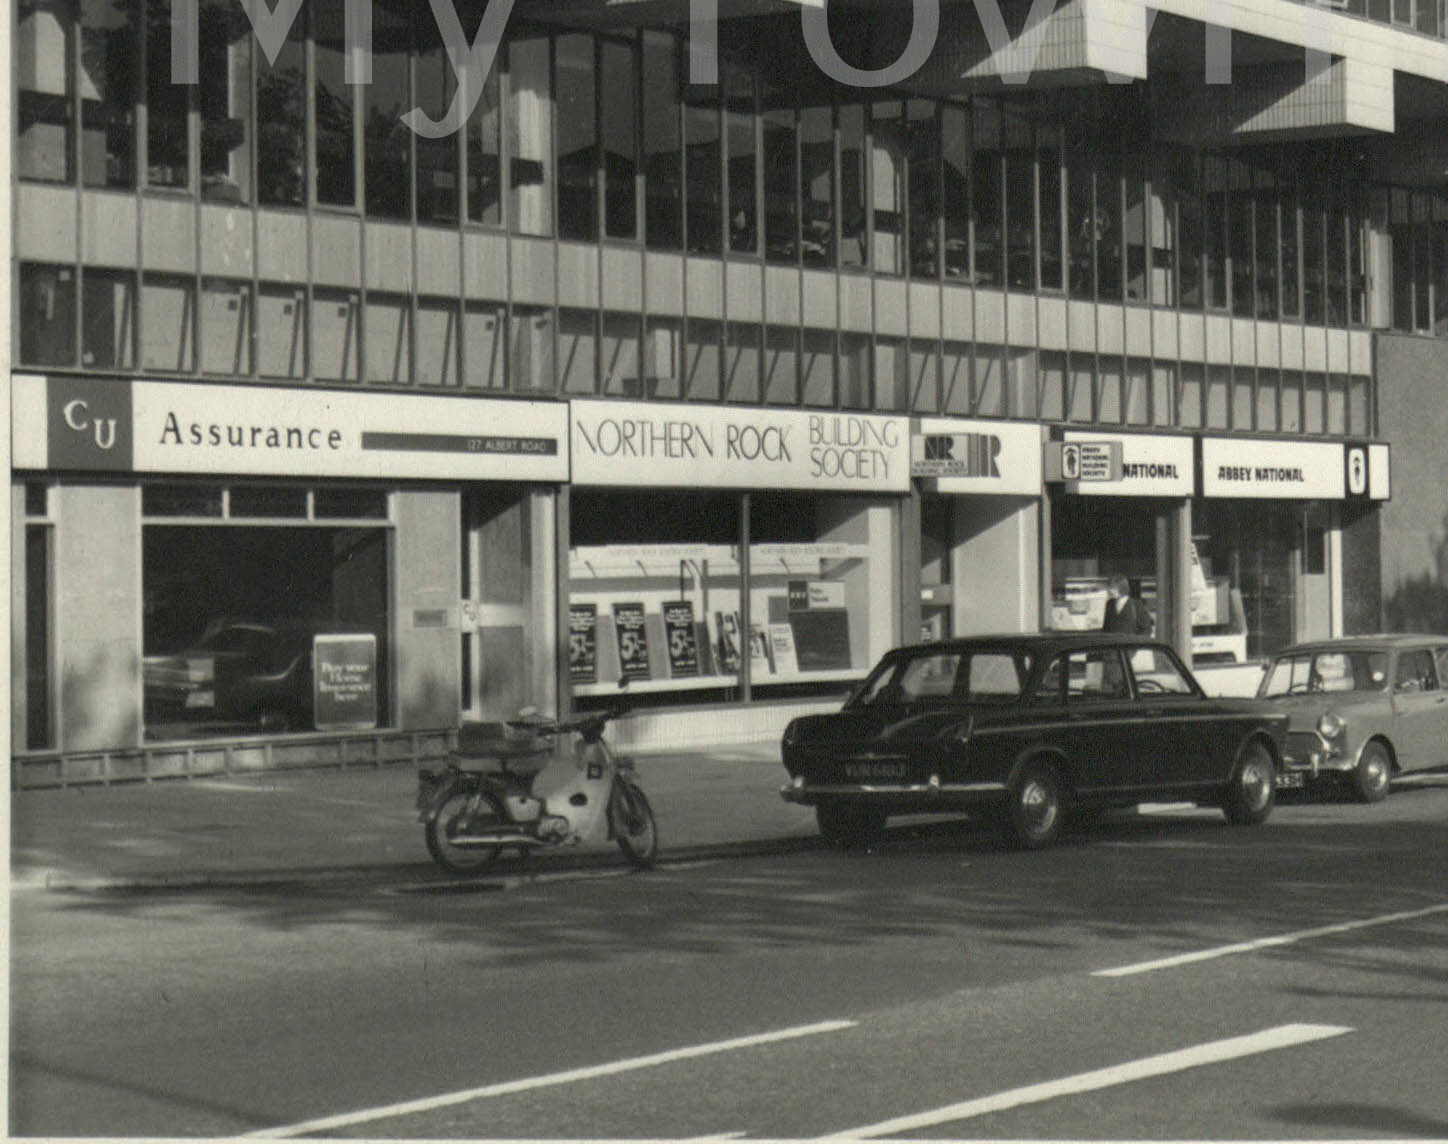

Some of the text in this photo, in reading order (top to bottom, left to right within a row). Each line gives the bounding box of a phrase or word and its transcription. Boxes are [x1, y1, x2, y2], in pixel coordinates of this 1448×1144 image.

[159, 411, 342, 450] Assurance
[485, 440, 517, 451] ALBERT
[520, 440, 546, 452] ROAD
[577, 419, 792, 463] NORTHERN ROCK
[809, 415, 898, 448] BUILDING
[810, 447, 889, 480] SOCIETY
[1123, 463, 1178, 480] NATIONAL
[1218, 466, 1304, 482] ABBEY NATIONAL
